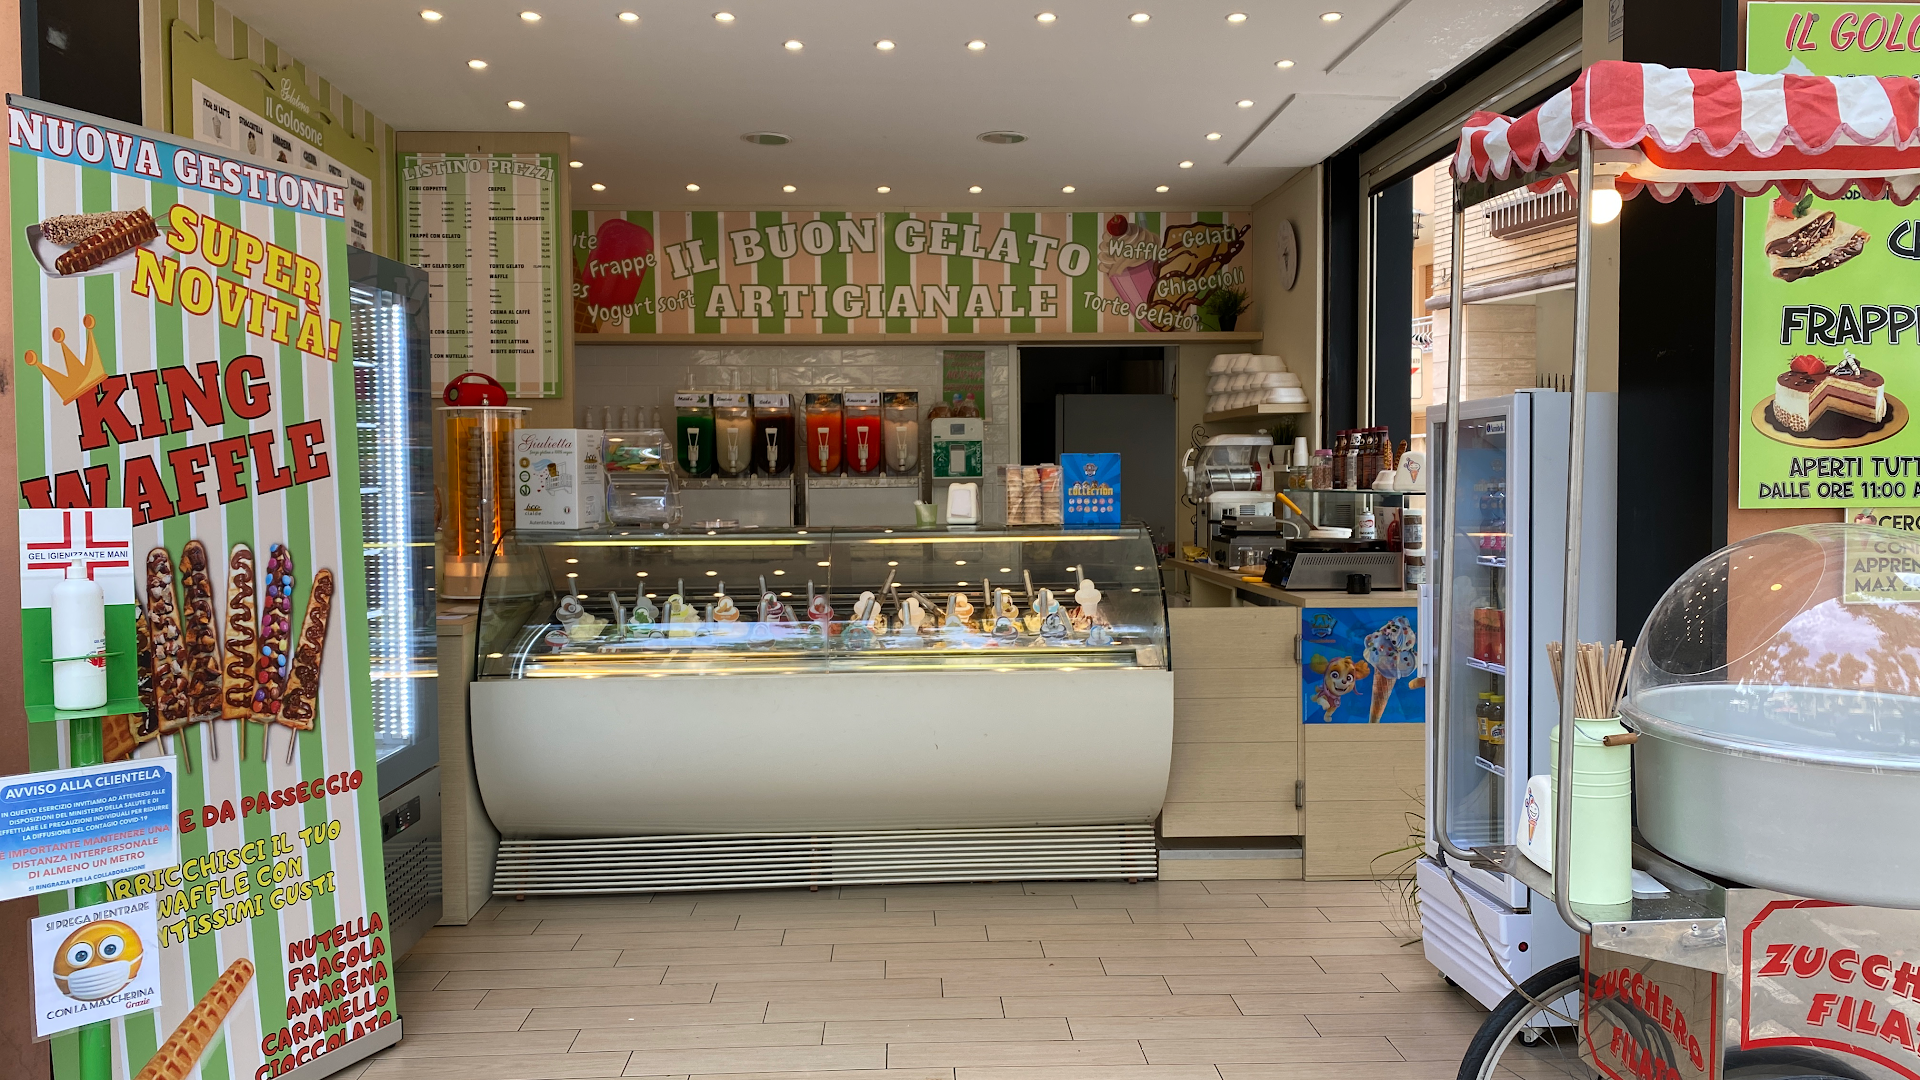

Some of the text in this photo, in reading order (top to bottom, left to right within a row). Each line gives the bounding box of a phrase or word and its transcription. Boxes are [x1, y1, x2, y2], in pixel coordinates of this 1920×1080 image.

[1785, 12, 1817, 52] IL
[219, 105, 231, 119] LATTE
[280, 77, 311, 114] Gelateria
[265, 96, 323, 147] Il Golosone
[8, 106, 346, 219] NUOVA GESTIONE
[403, 159, 555, 182] LISTINO PREZZI
[572, 230, 598, 250] ite
[663, 217, 1092, 281] IL BUON GELATO
[1107, 238, 1169, 263] Waffle
[1181, 223, 1238, 249] Gelati
[166, 203, 323, 305] SUPER
[1156, 265, 1245, 299] Ghiaccioli
[131, 246, 343, 363] NOVITÀ!
[658, 289, 697, 314] soft
[704, 283, 1058, 319] ARTIGIANALE
[1083, 291, 1194, 330] Torte Gelato
[1779, 303, 1920, 347] FRAPP
[75, 354, 272, 451] KING
[517, 433, 573, 453] Giulietta
[20, 419, 331, 527] WAFFLE
[1788, 455, 1864, 479] APERTI
[1068, 487, 1114, 496] COLLECTION
[1758, 480, 1906, 499] DALLE ORE 11:00
[28, 552, 46, 560] GEL
[107, 550, 128, 558] MANI
[1854, 575, 1898, 592] MAX
[5, 769, 161, 800] AVVISO ALLA CLIENTELA
[201, 800, 236, 828] DA
[240, 768, 364, 818] PASSEGGIO
[9, 814, 55, 826] DISPOSIZIONI
[68, 806, 104, 817] MINISTERO
[104, 803, 124, 812] DELLA
[124, 799, 147, 808] SALUTE
[10, 807, 38, 817] QUESTO
[39, 802, 73, 813] ESERCIZIO
[73, 797, 107, 808] INVITIAMO
[108, 795, 118, 803] AD
[118, 790, 151, 801] ATTENERSI
[151, 788, 166, 796] ALLE
[49, 816, 93, 829] PRECAUZIONI
[93, 810, 131, 822] INDIVIDUALI
[131, 807, 143, 815] PER
[143, 803, 169, 813] RIDURRE
[8, 824, 171, 859] IMPORTANTE MANTENERE UNA
[22, 815, 148, 842] LA DIFFUSIONE DEL CONTAGIO COVID-19
[270, 831, 294, 858] IL
[298, 819, 342, 848] TUO
[12, 836, 159, 871] DISTANZA INTERPERSONALE
[28, 850, 145, 880] DI ALMENO UN METRO
[35, 879, 71, 890] RINGRAZIA
[93, 863, 146, 880] COLLABORAZIONE
[156, 855, 303, 922] WAFFLE CON
[46, 901, 150, 932] SI PREGA DI ENTRARE
[157, 871, 337, 949] NTISSIMI GUSTI
[288, 911, 384, 964] NUTELLA
[288, 936, 386, 991] FRAGOLA
[46, 986, 155, 1020] CON LA MASCHERINA
[125, 997, 151, 1009] Grazie
[286, 960, 388, 1021] AMARENA
[261, 985, 390, 1057] CARAMELLO
[1592, 967, 1705, 1072] ZUCCHERO
[1806, 993, 1920, 1058] FILA
